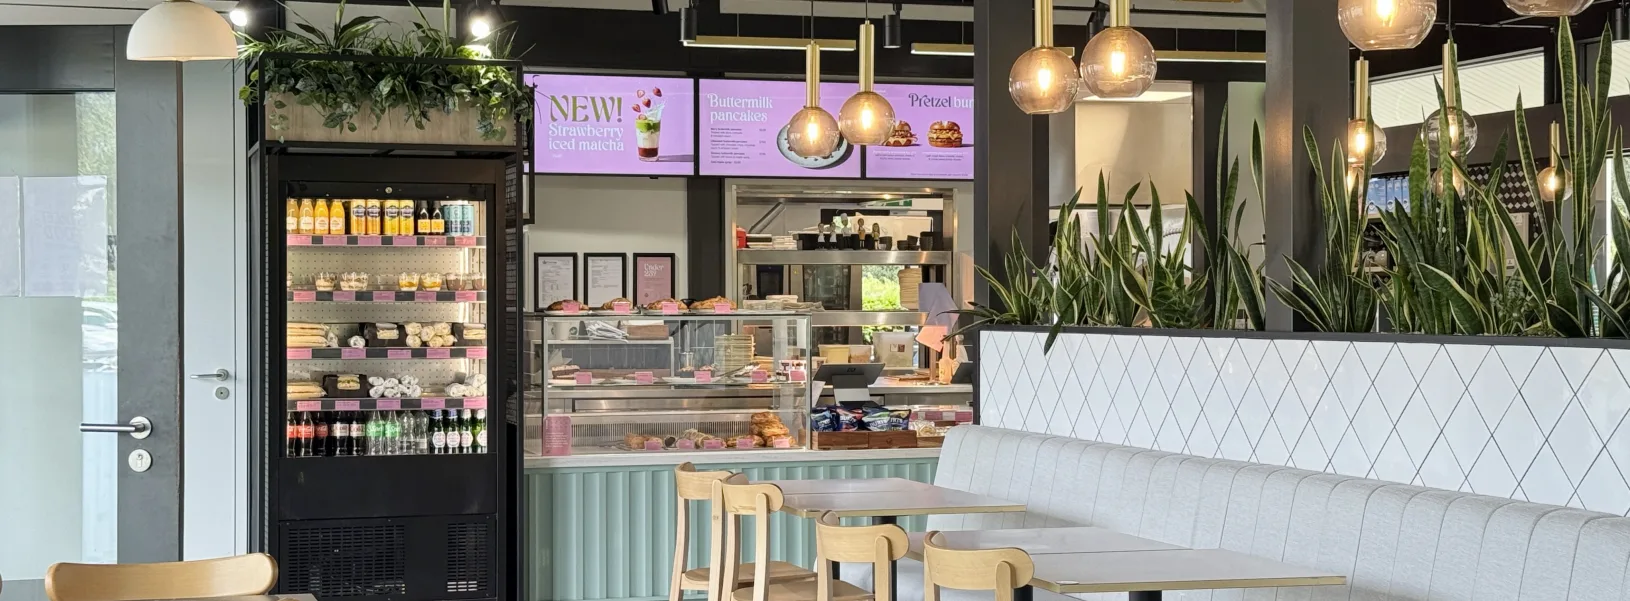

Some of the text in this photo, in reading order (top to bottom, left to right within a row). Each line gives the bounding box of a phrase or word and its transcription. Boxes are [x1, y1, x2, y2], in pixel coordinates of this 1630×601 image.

[707, 92, 774, 109] Buttermilk
[908, 92, 952, 108] Pretzel
[549, 95, 623, 123] NEW!
[709, 109, 768, 124] pancakes
[548, 123, 624, 141] Strawberry
[548, 138, 625, 152] iced matcha
